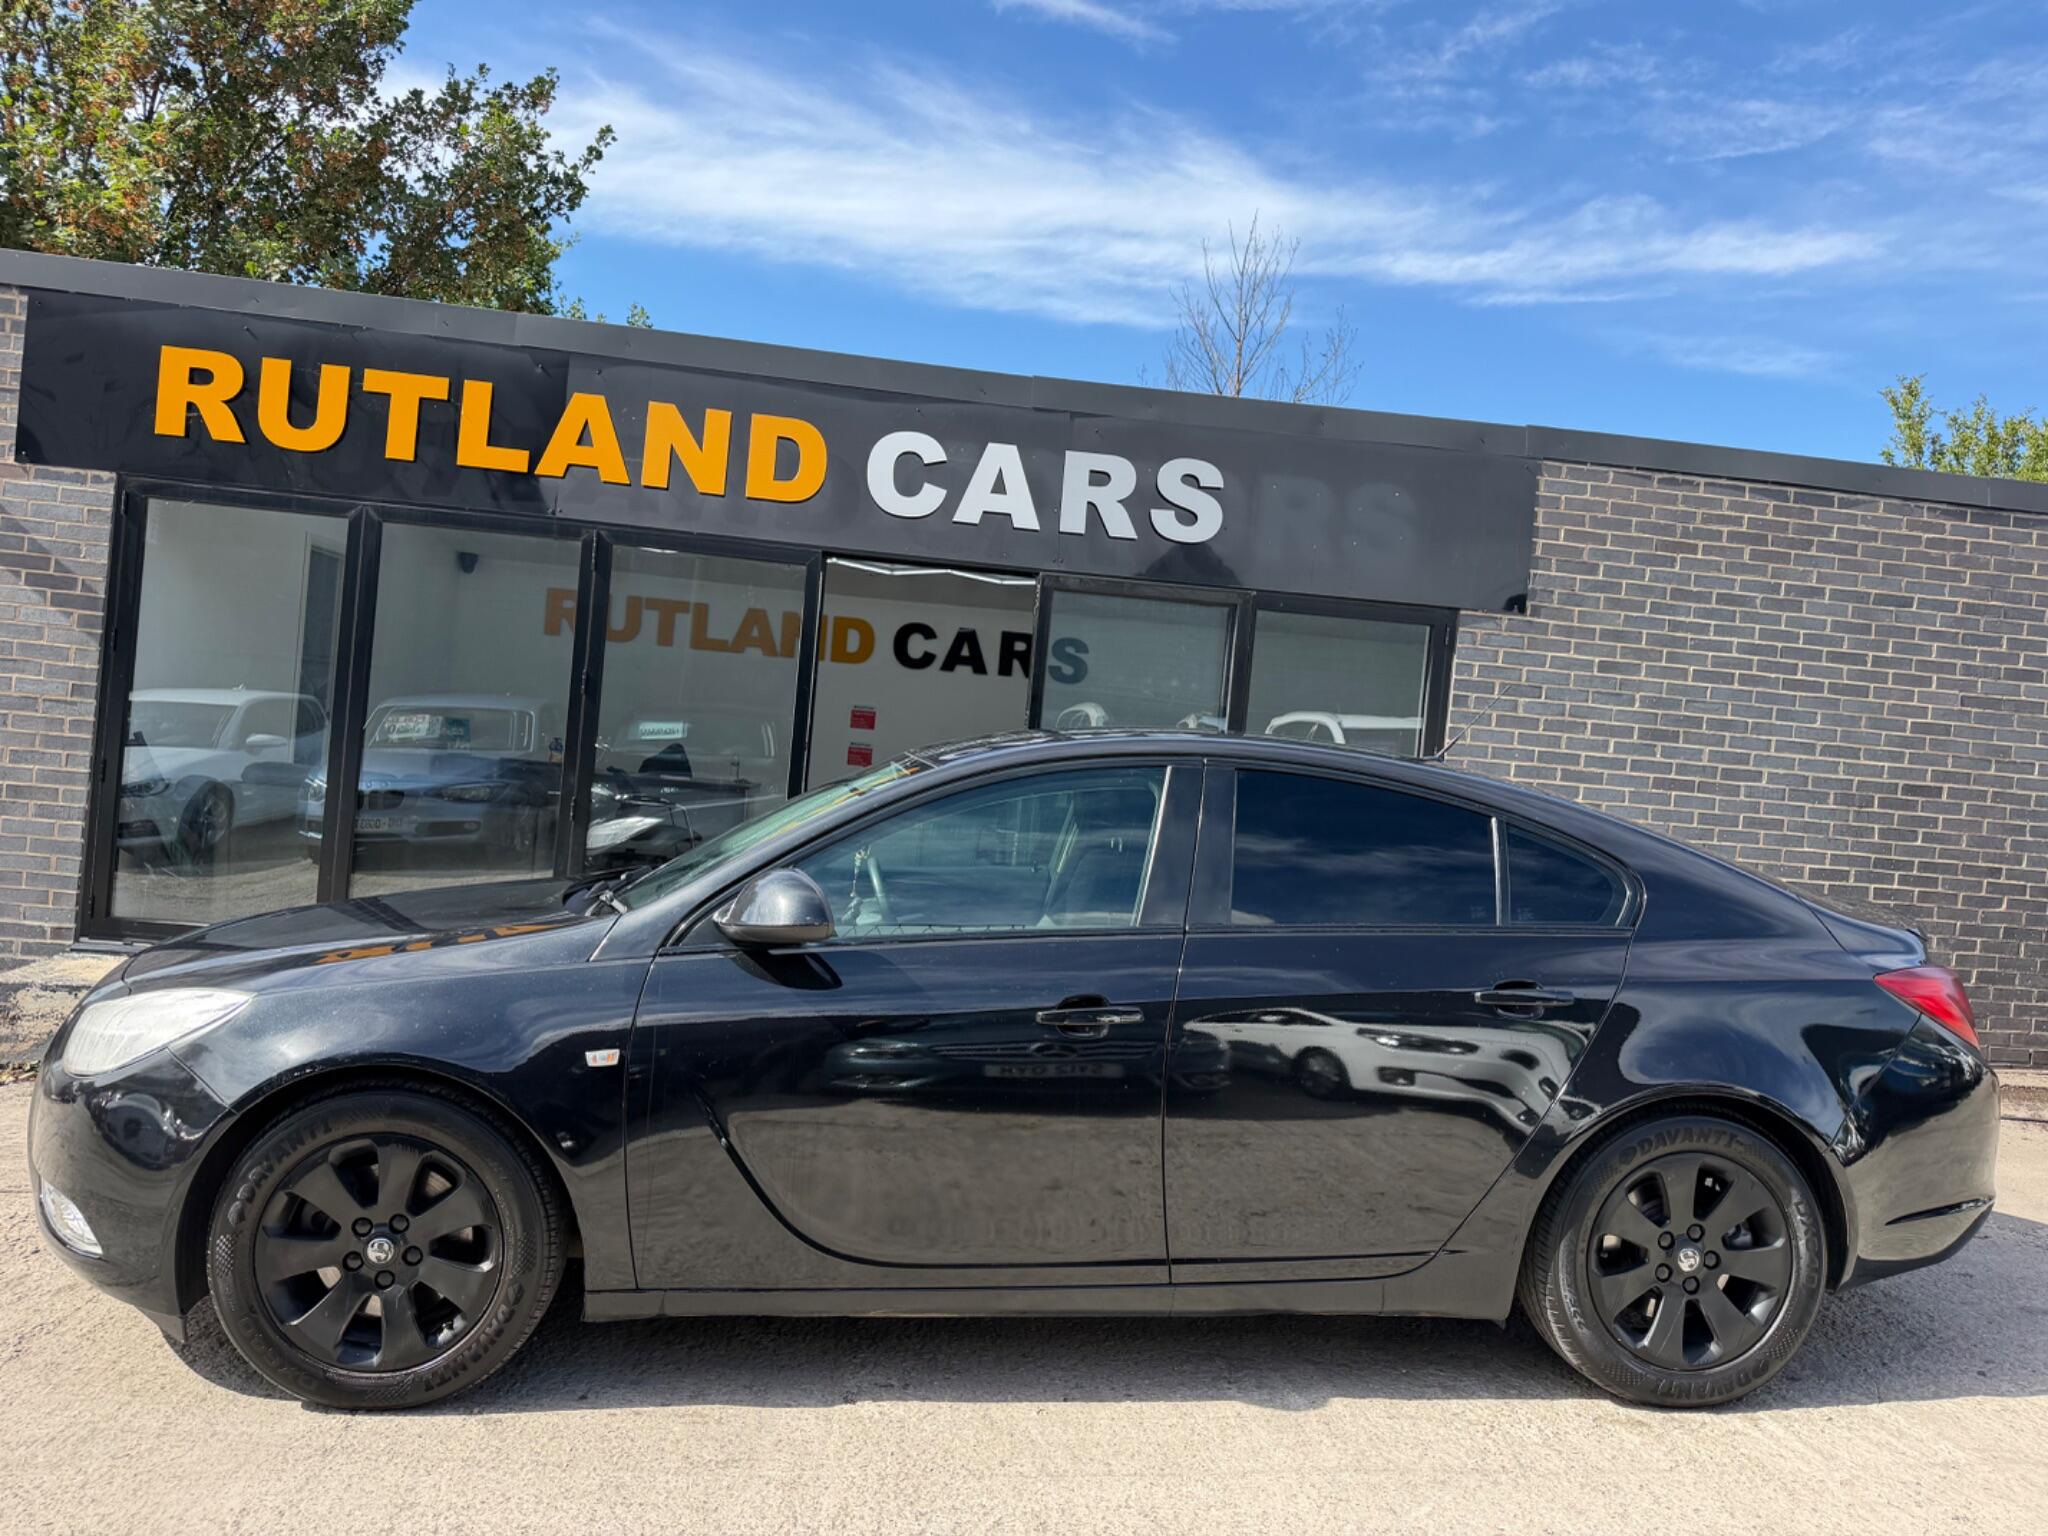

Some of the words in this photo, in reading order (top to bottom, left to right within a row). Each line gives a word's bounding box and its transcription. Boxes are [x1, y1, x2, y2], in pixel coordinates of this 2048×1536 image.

[156, 346, 828, 502] RUTLAND
[867, 431, 1226, 544] CARS
[544, 588, 875, 664] RUTLAND
[892, 621, 1089, 684] CARS
[1634, 1126, 1738, 1154] DAVANTI
